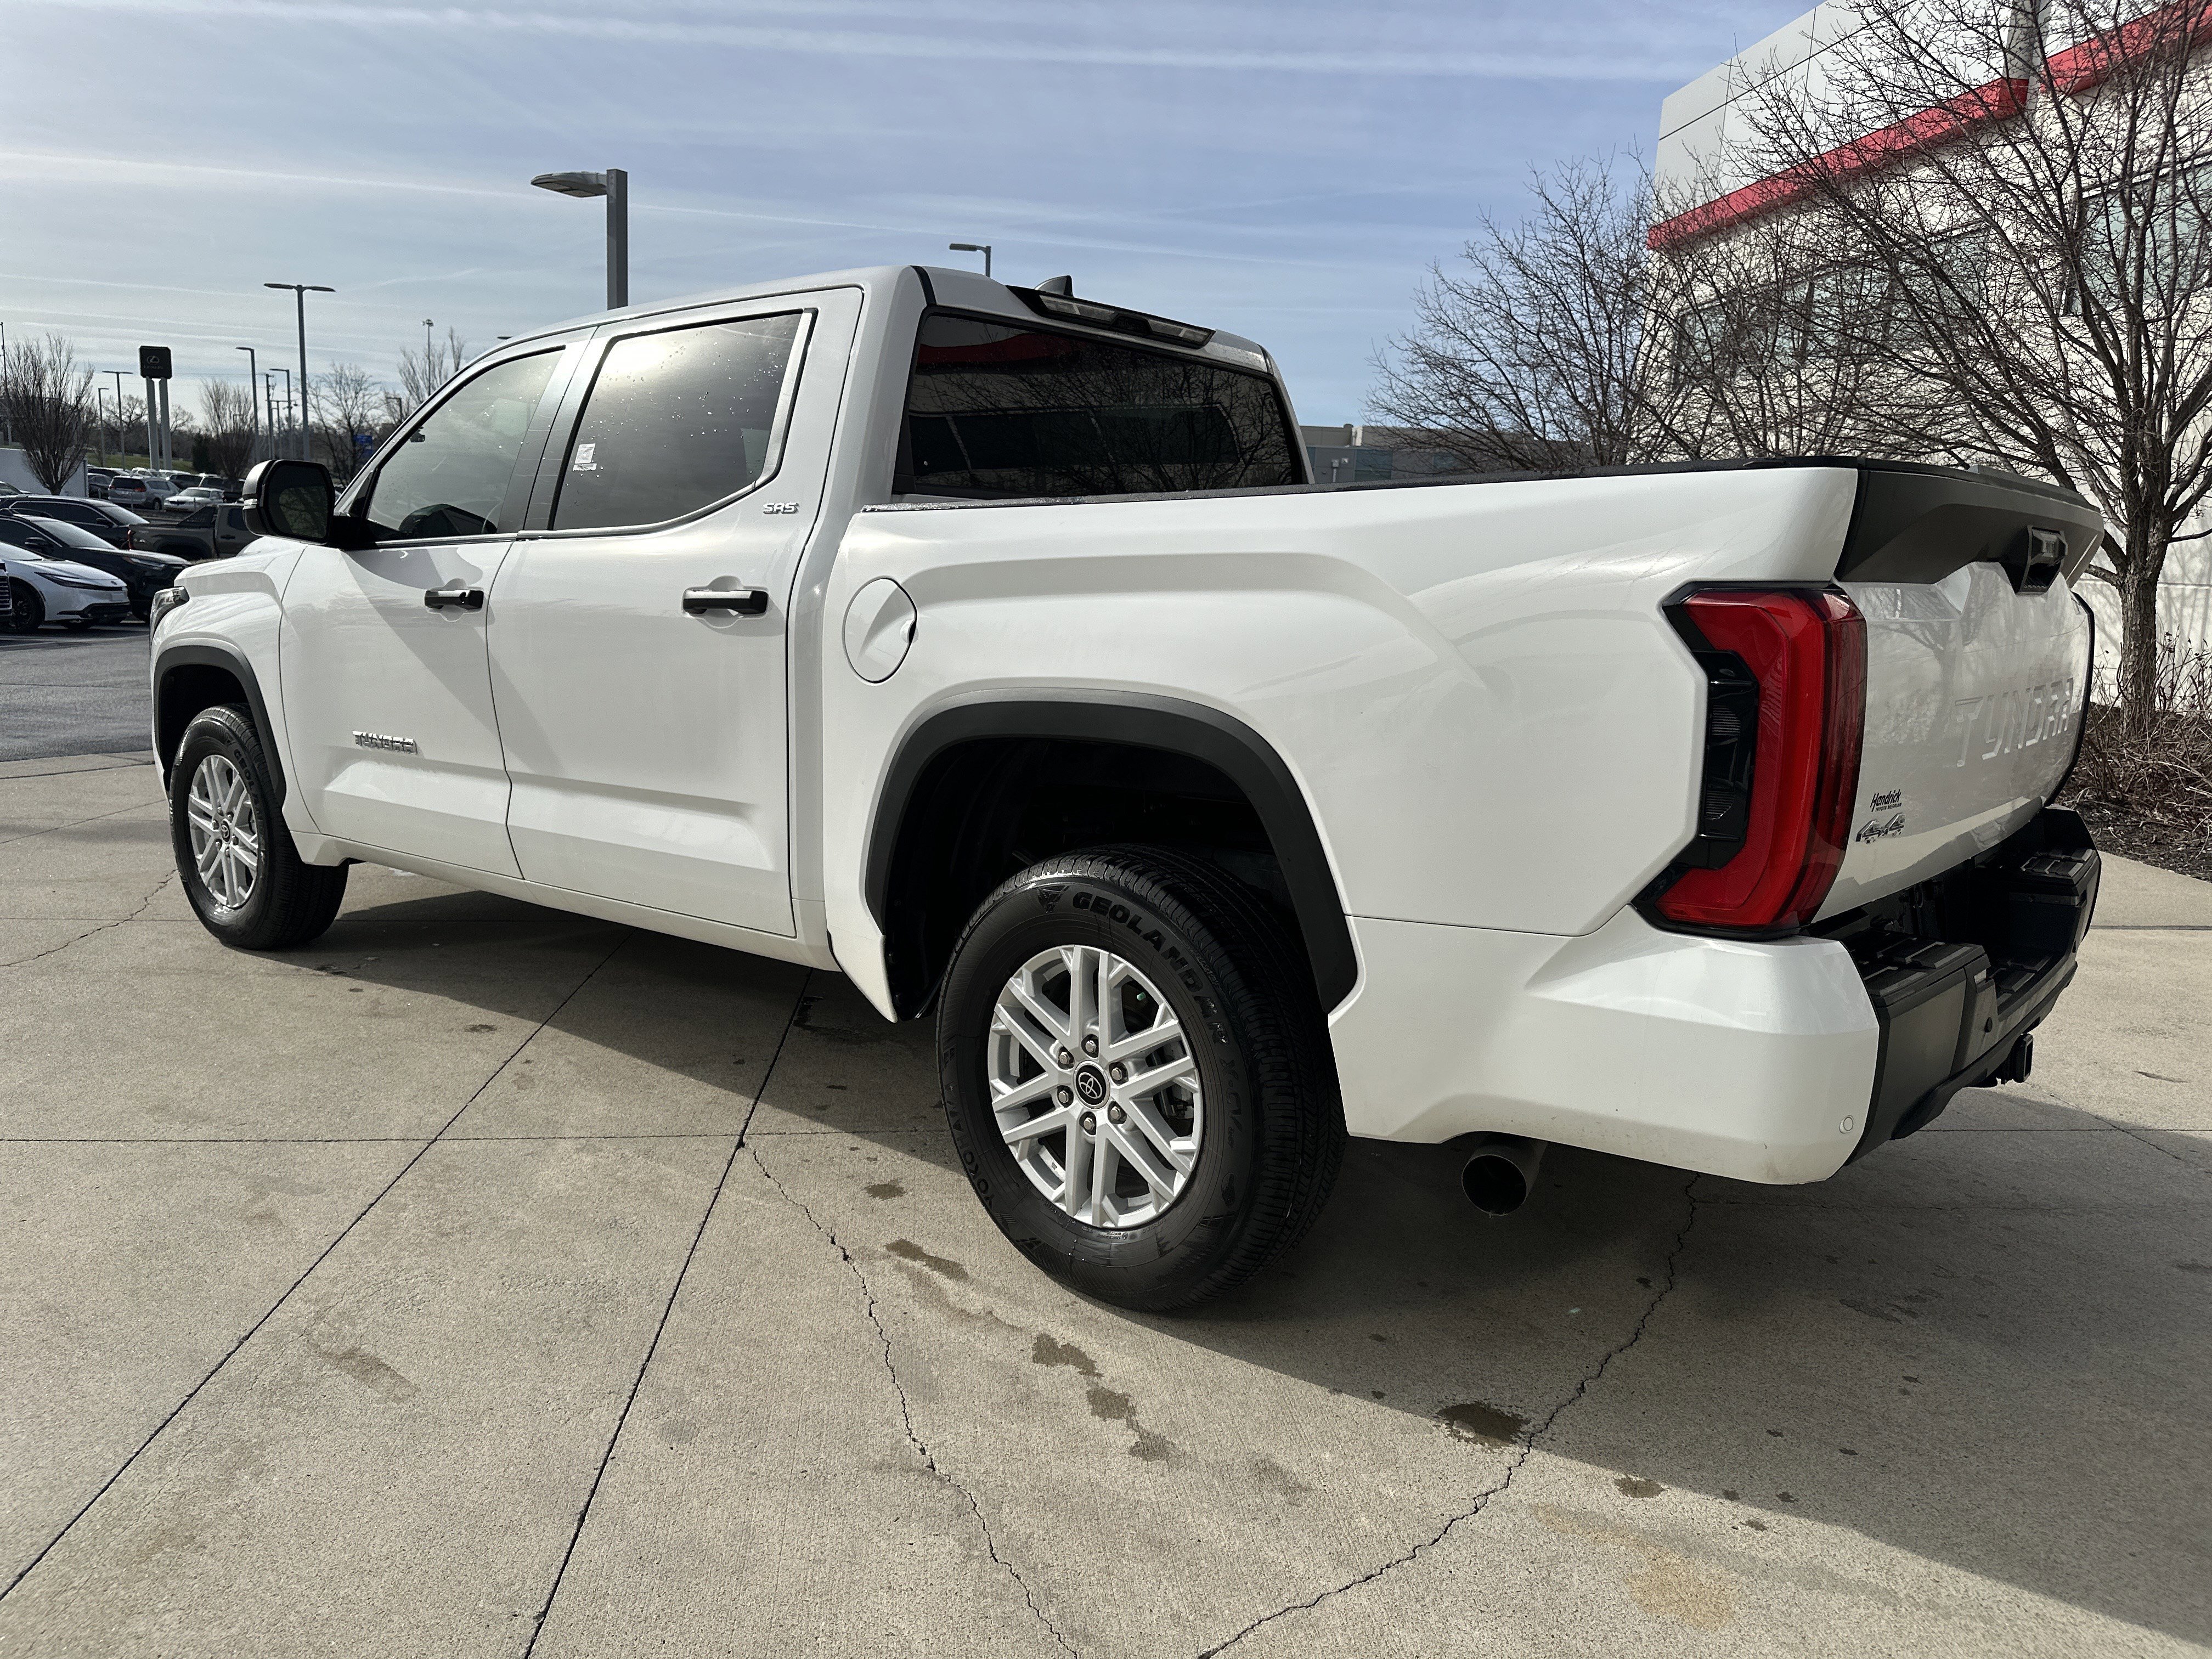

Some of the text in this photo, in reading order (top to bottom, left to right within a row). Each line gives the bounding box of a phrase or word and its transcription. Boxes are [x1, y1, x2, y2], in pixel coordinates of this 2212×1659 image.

[763, 502, 799, 515] SR5
[1955, 677, 2074, 768] TUNDRA
[352, 730, 418, 755] TUNDRA
[1870, 789, 1902, 812] Hendrick
[1073, 891, 1230, 1047] GEOLANDAR
